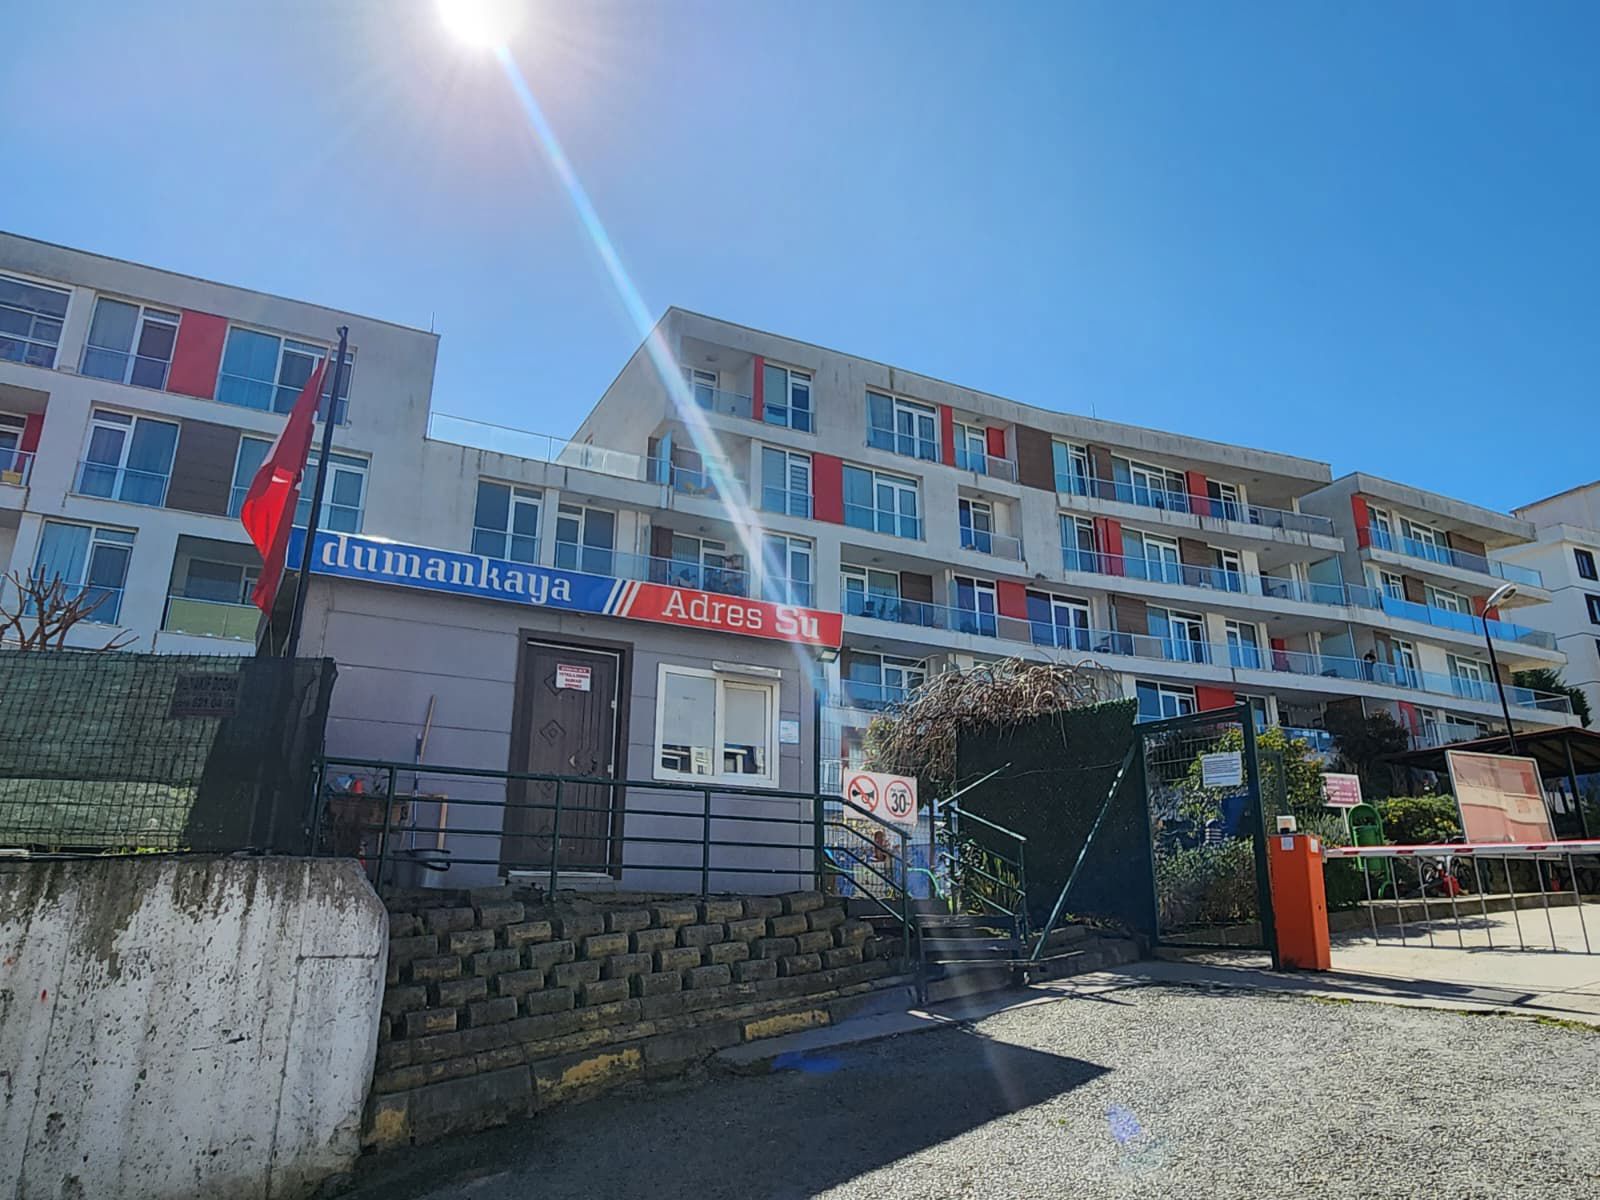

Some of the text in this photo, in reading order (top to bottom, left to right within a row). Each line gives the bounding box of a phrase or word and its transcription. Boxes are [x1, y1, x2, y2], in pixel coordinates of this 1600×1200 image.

[321, 534, 572, 605] dumankaya
[661, 590, 821, 640] Adres Su
[891, 792, 906, 814] 30
